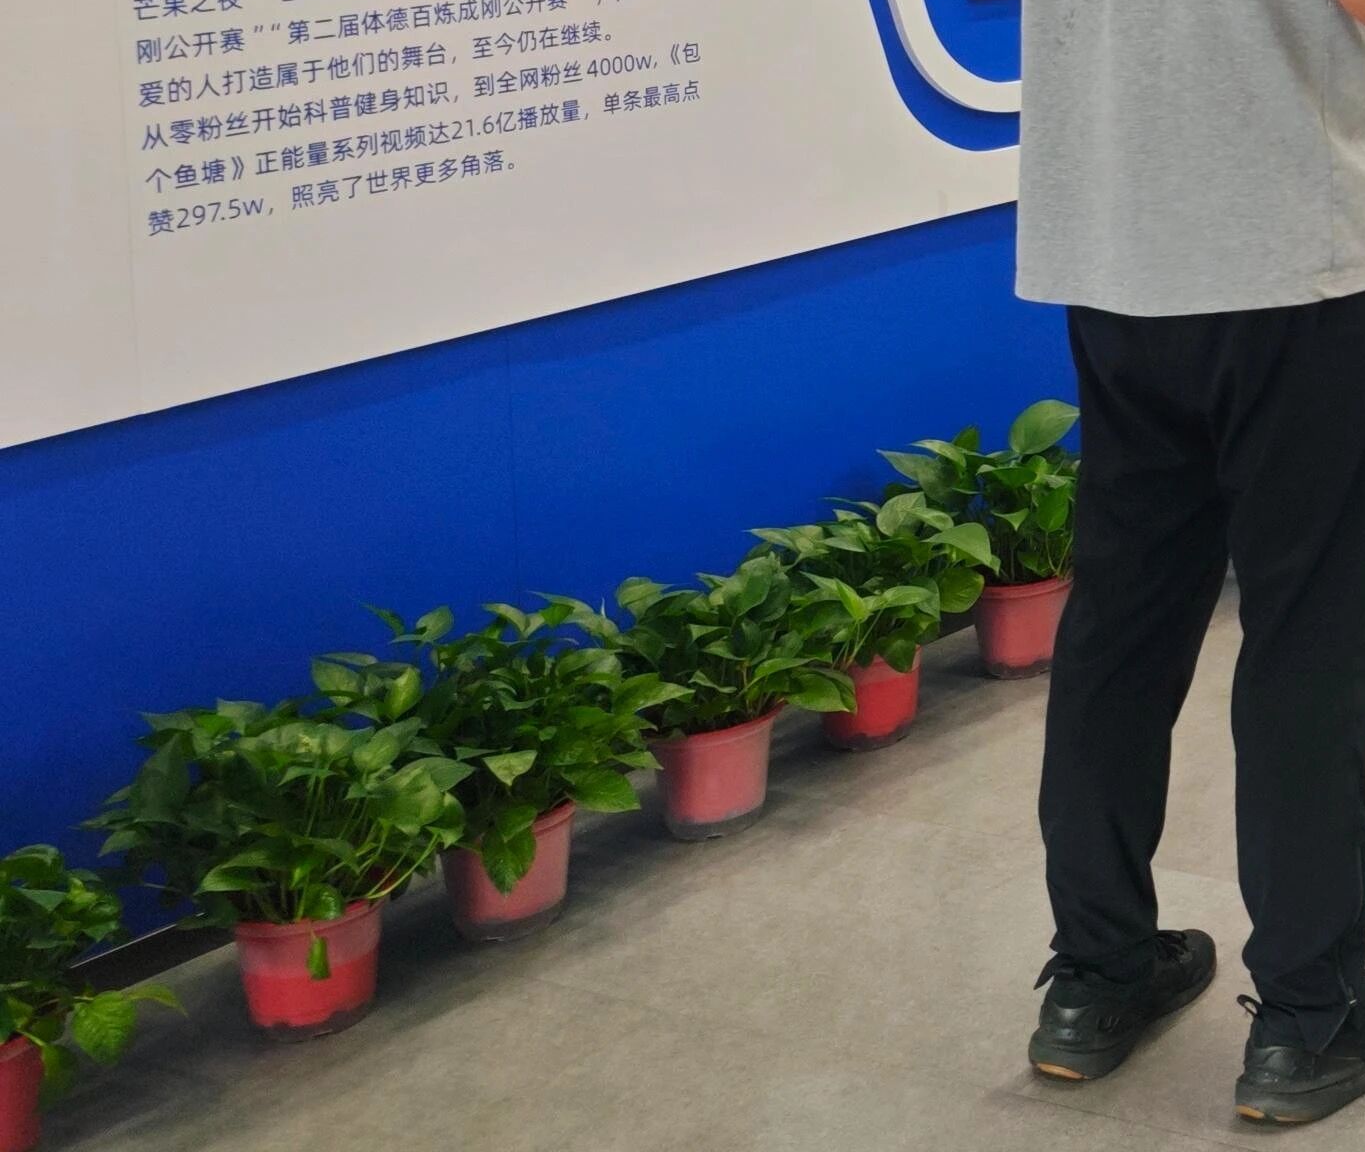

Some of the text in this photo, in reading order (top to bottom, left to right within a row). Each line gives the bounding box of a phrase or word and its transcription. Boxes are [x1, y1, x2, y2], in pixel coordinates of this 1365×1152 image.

[139, 21, 613, 108] 爱的人打造属于他们的舞台，至今仍在继续。
[145, 80, 701, 194] 个鱼塘》正能量系列视频达21.6亿播放量，单条最高点
[147, 149, 516, 237] 赞297.5w，照亮了世界更多角落。
